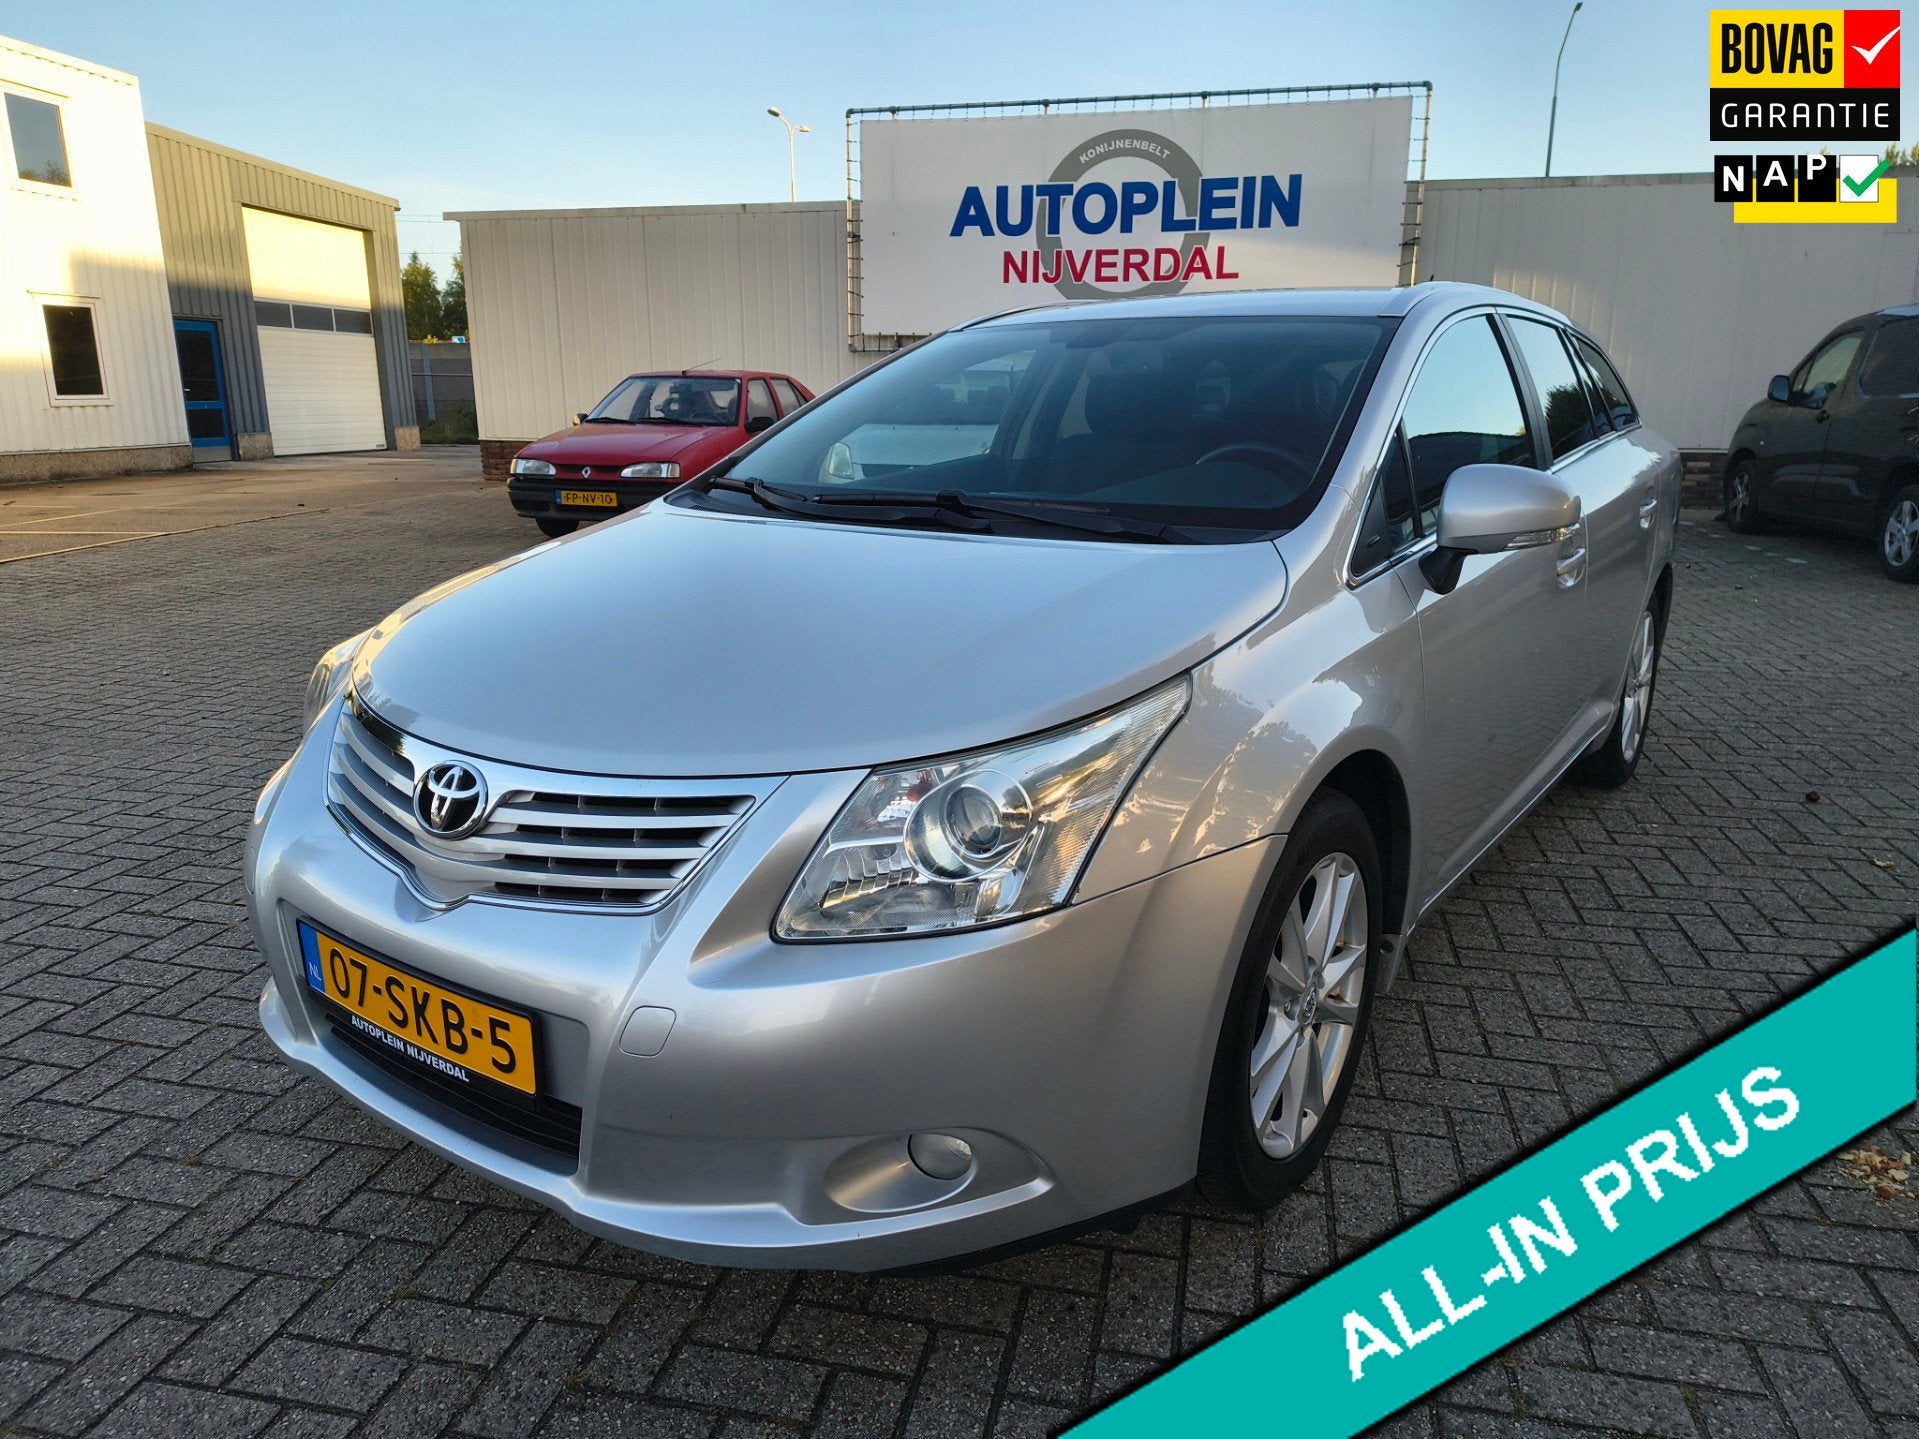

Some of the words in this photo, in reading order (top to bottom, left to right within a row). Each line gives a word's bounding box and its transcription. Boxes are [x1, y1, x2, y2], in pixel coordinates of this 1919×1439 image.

[1078, 138, 1171, 164] KONIJNENBELT
[949, 173, 1303, 238] AUTOPLEIN
[1002, 246, 1240, 284] NIJVERDAL
[565, 492, 613, 505] FP-NV-10
[308, 961, 322, 981] NL
[329, 947, 517, 1074] 07-SKB-5
[351, 1014, 405, 1053] AUTOPLEIN
[406, 1044, 470, 1083] NIJVERDAL
